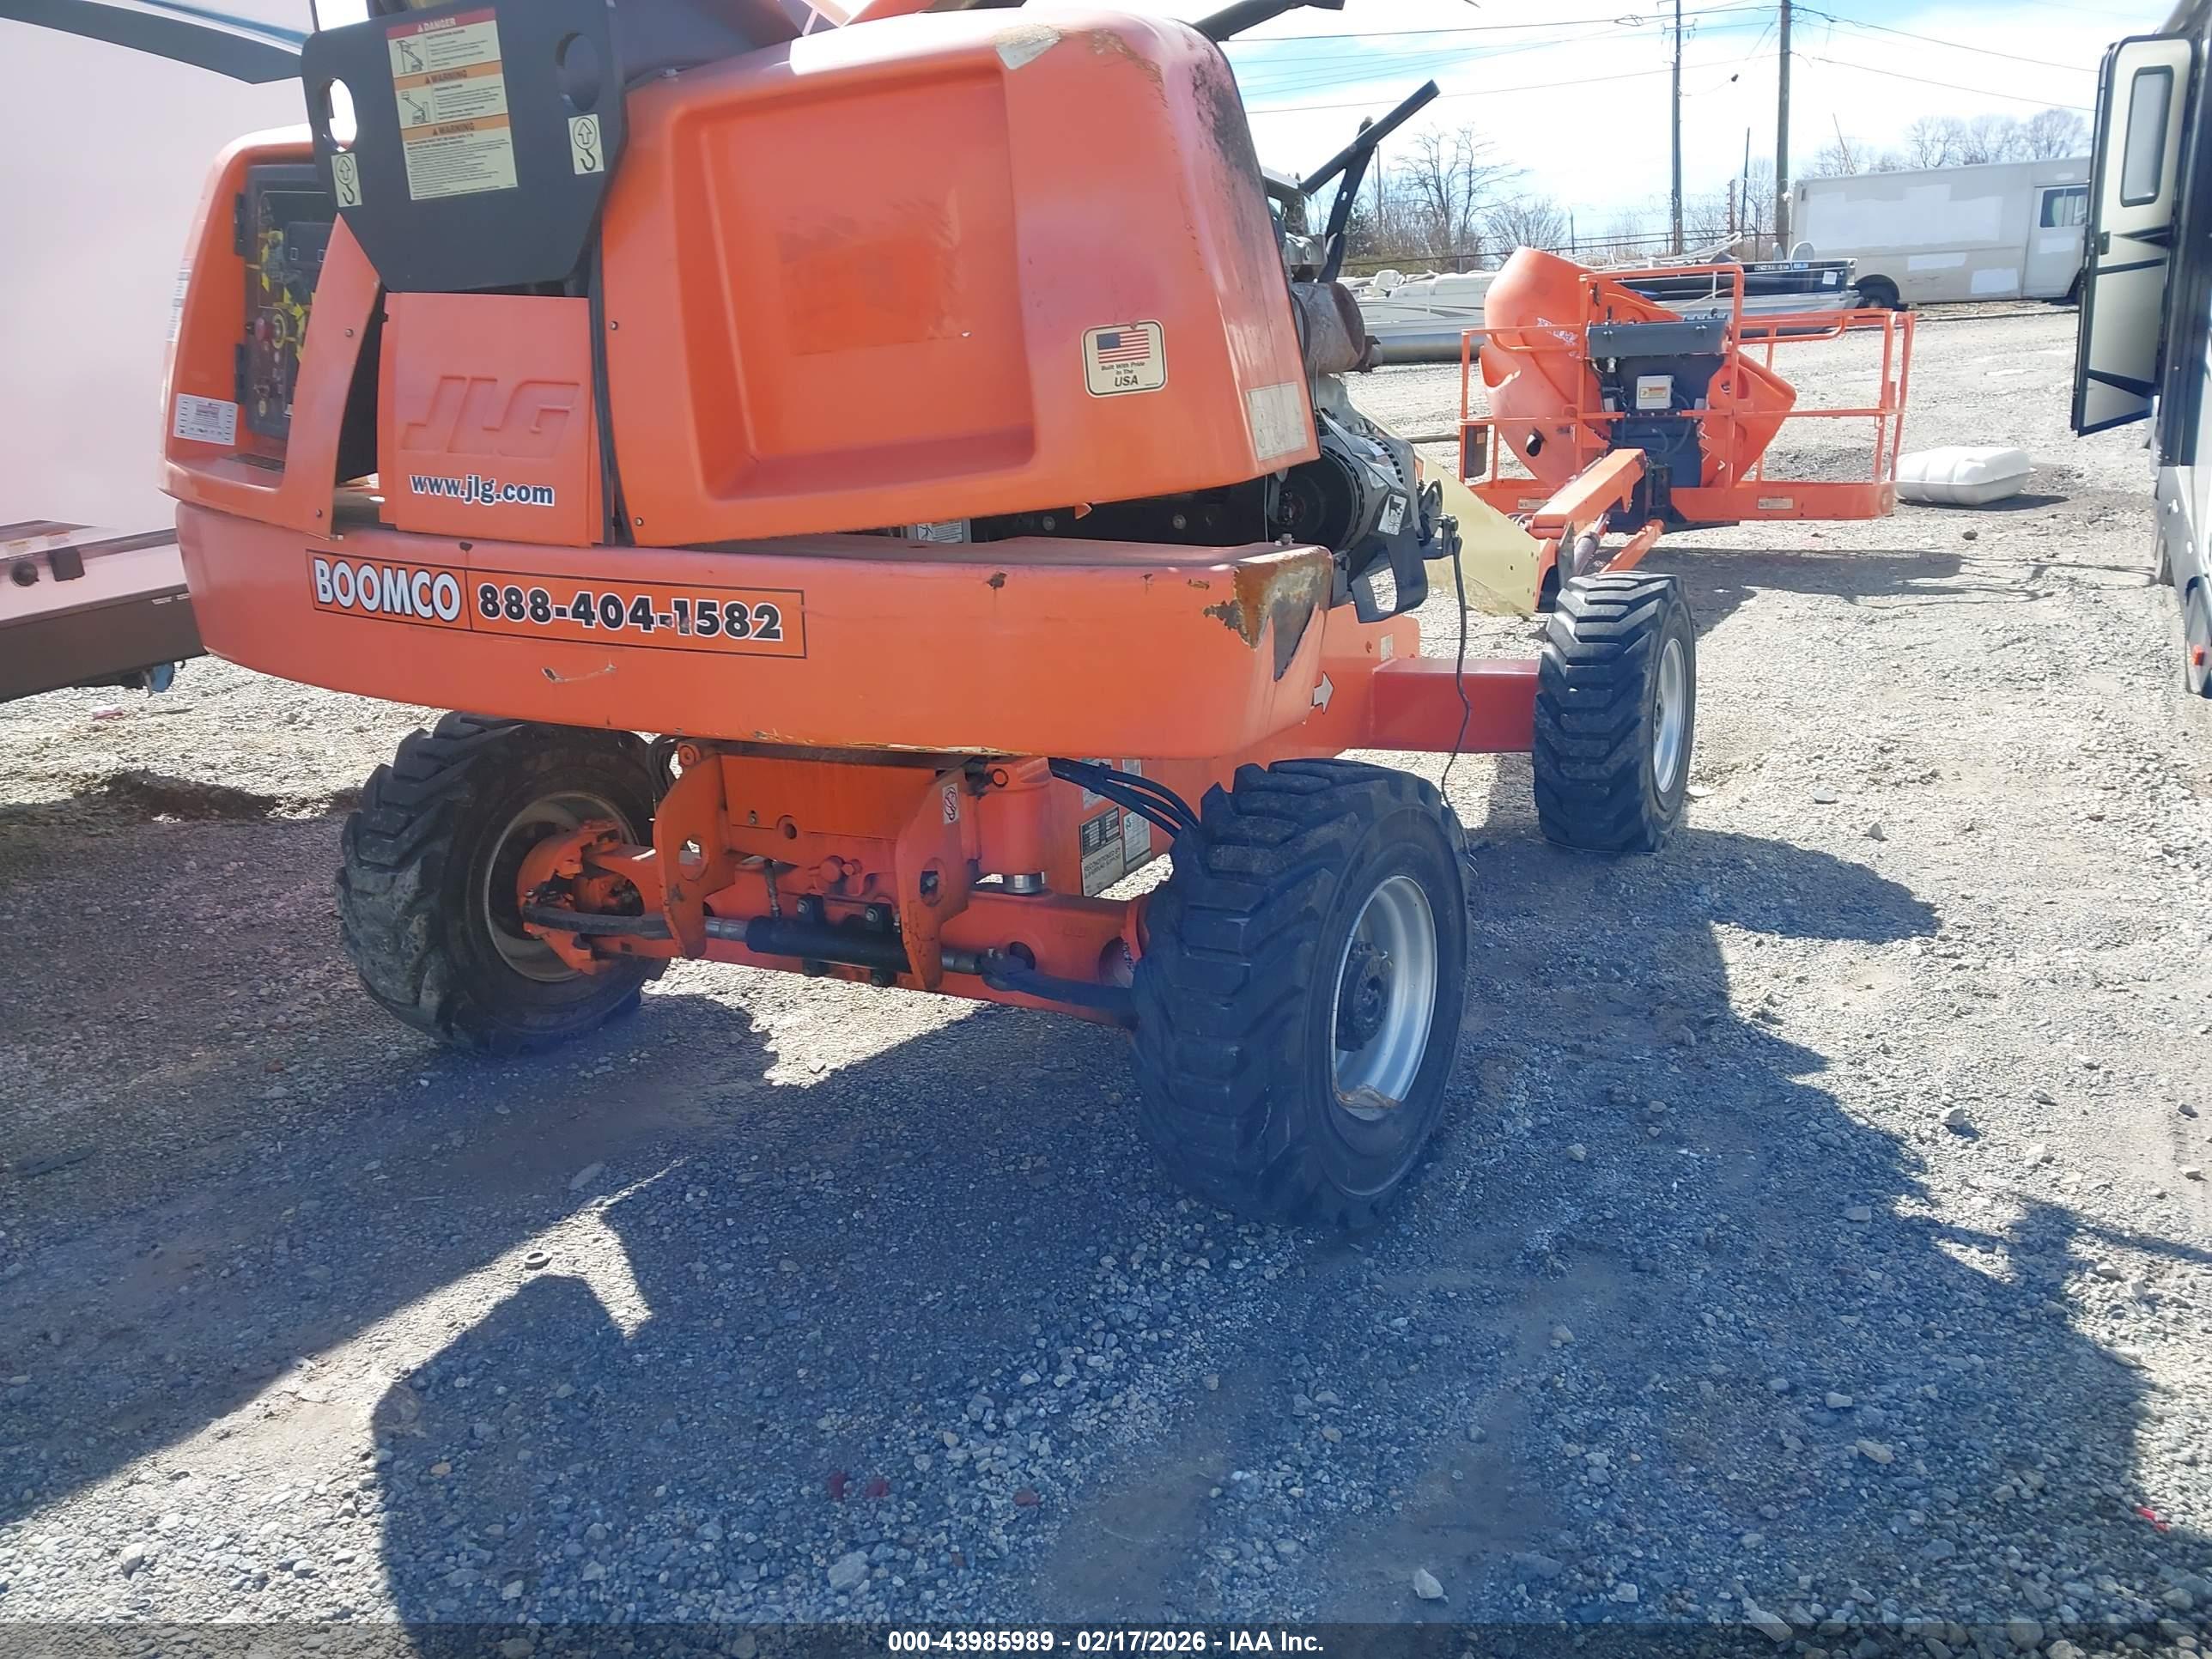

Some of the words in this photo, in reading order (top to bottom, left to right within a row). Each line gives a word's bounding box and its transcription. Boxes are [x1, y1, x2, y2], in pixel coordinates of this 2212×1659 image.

[424, 17, 457, 32] DANGER
[1115, 374, 1139, 387] USA
[400, 375, 580, 459] JLG
[410, 475, 556, 507] www.jlg.com
[313, 557, 462, 623] BOOMCO
[477, 582, 784, 641] 888-404-1582
